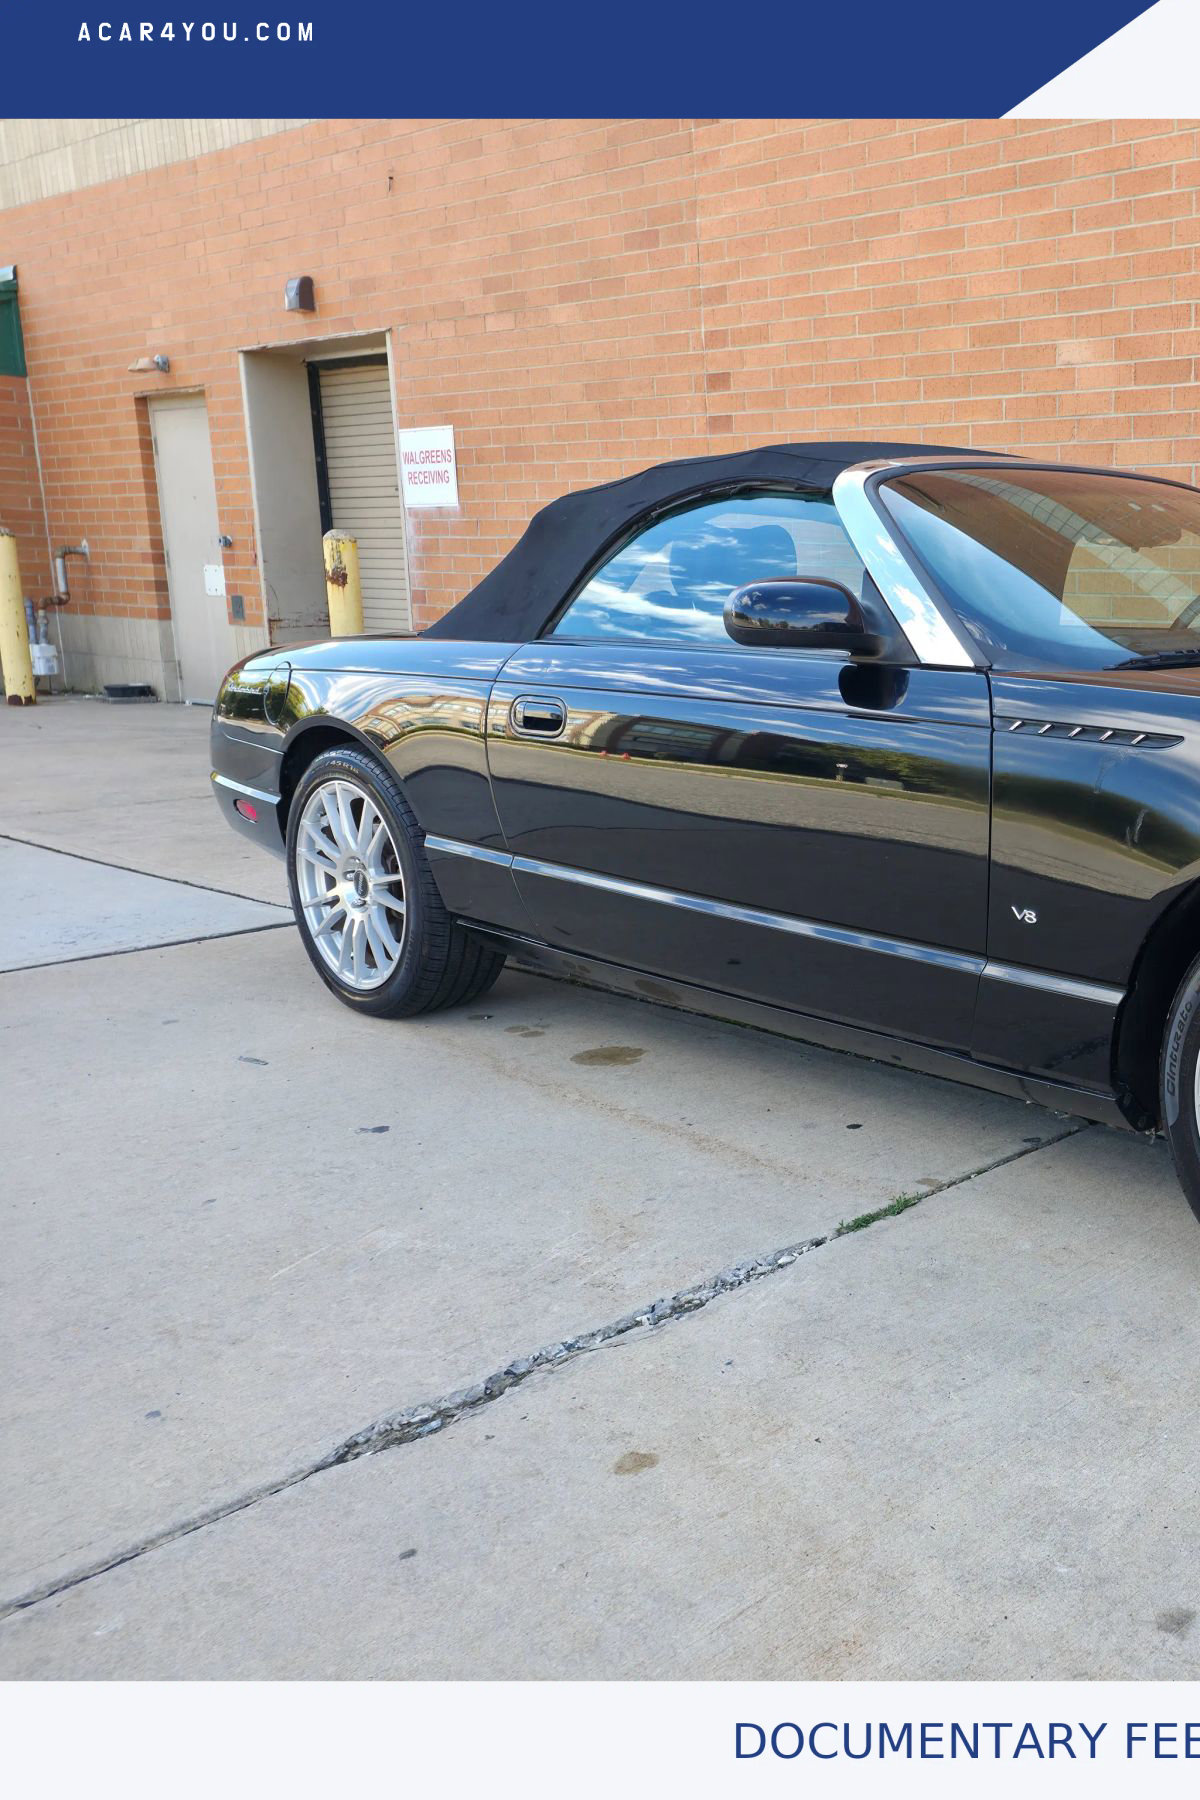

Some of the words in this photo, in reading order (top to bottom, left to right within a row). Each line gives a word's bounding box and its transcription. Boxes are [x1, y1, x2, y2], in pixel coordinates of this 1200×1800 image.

[402, 449, 453, 465] WALGREENS
[407, 470, 450, 485] RECEIVING
[1011, 906, 1037, 923] V8
